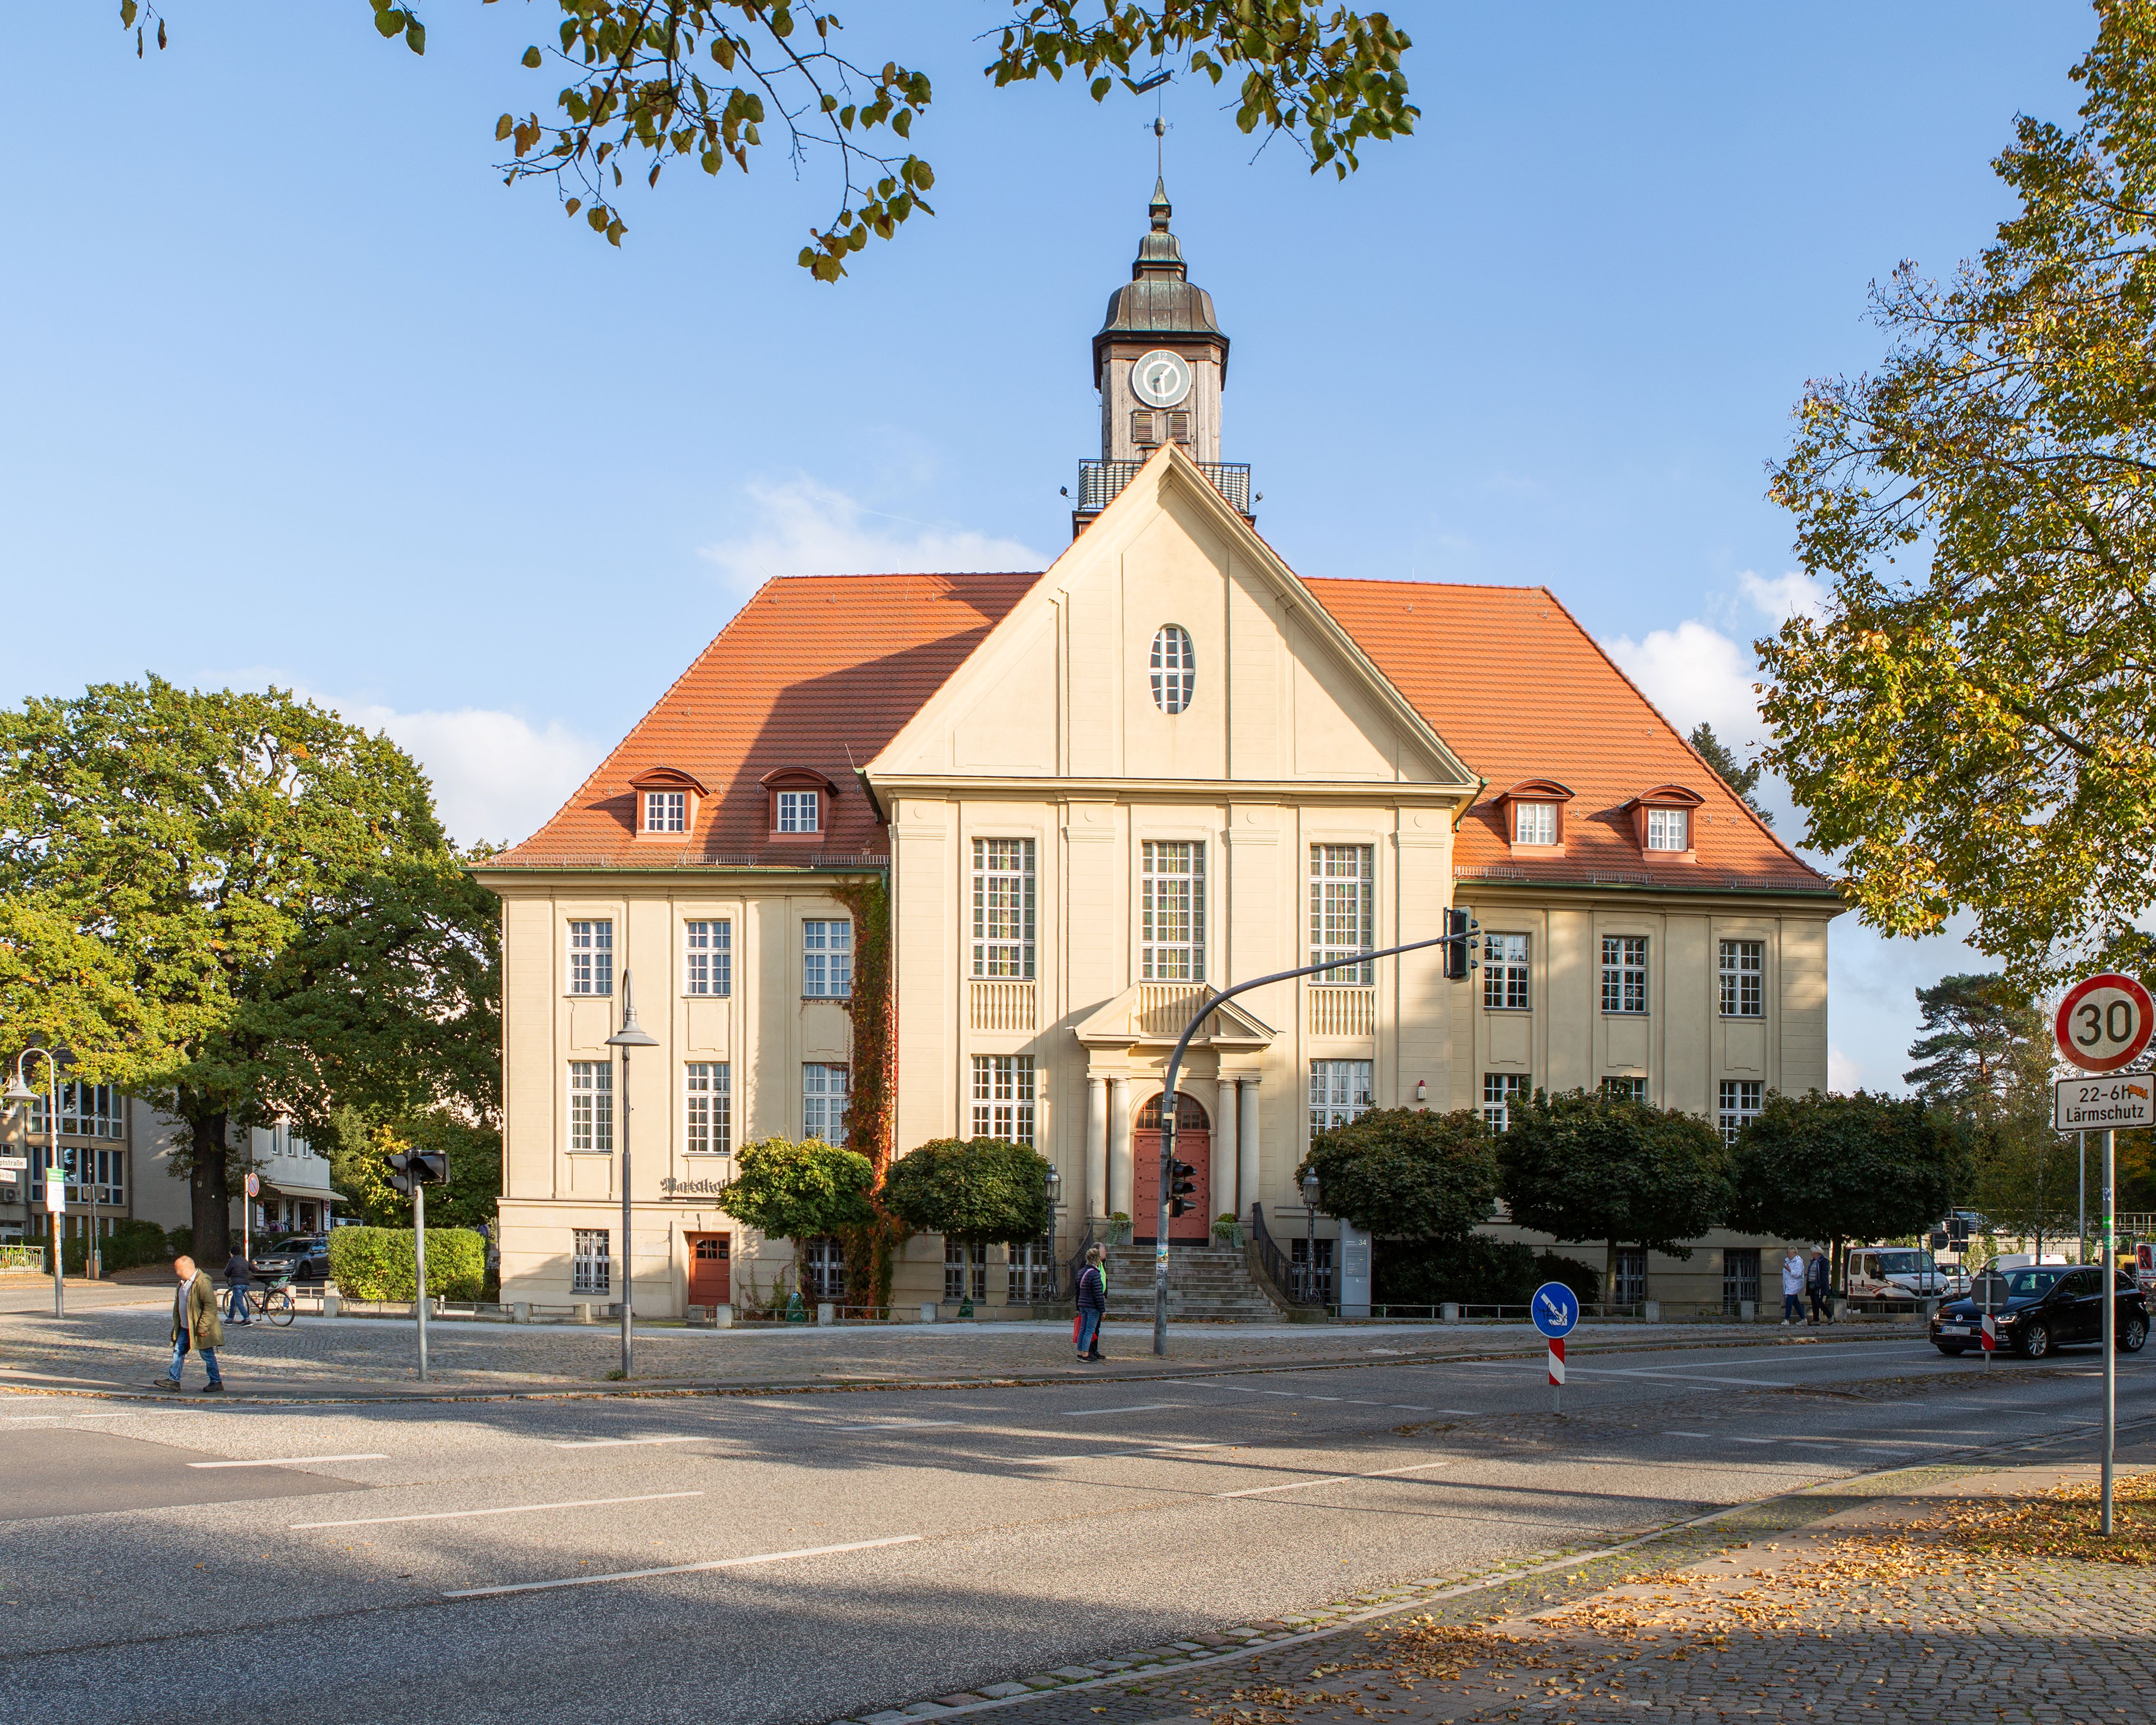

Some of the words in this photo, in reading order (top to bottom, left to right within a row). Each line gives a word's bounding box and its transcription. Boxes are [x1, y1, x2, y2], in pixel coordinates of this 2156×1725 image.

[2077, 1000, 2132, 1046] 30
[2080, 1085, 2131, 1103] 22-6h
[2067, 1104, 2144, 1122] Lärmschutz
